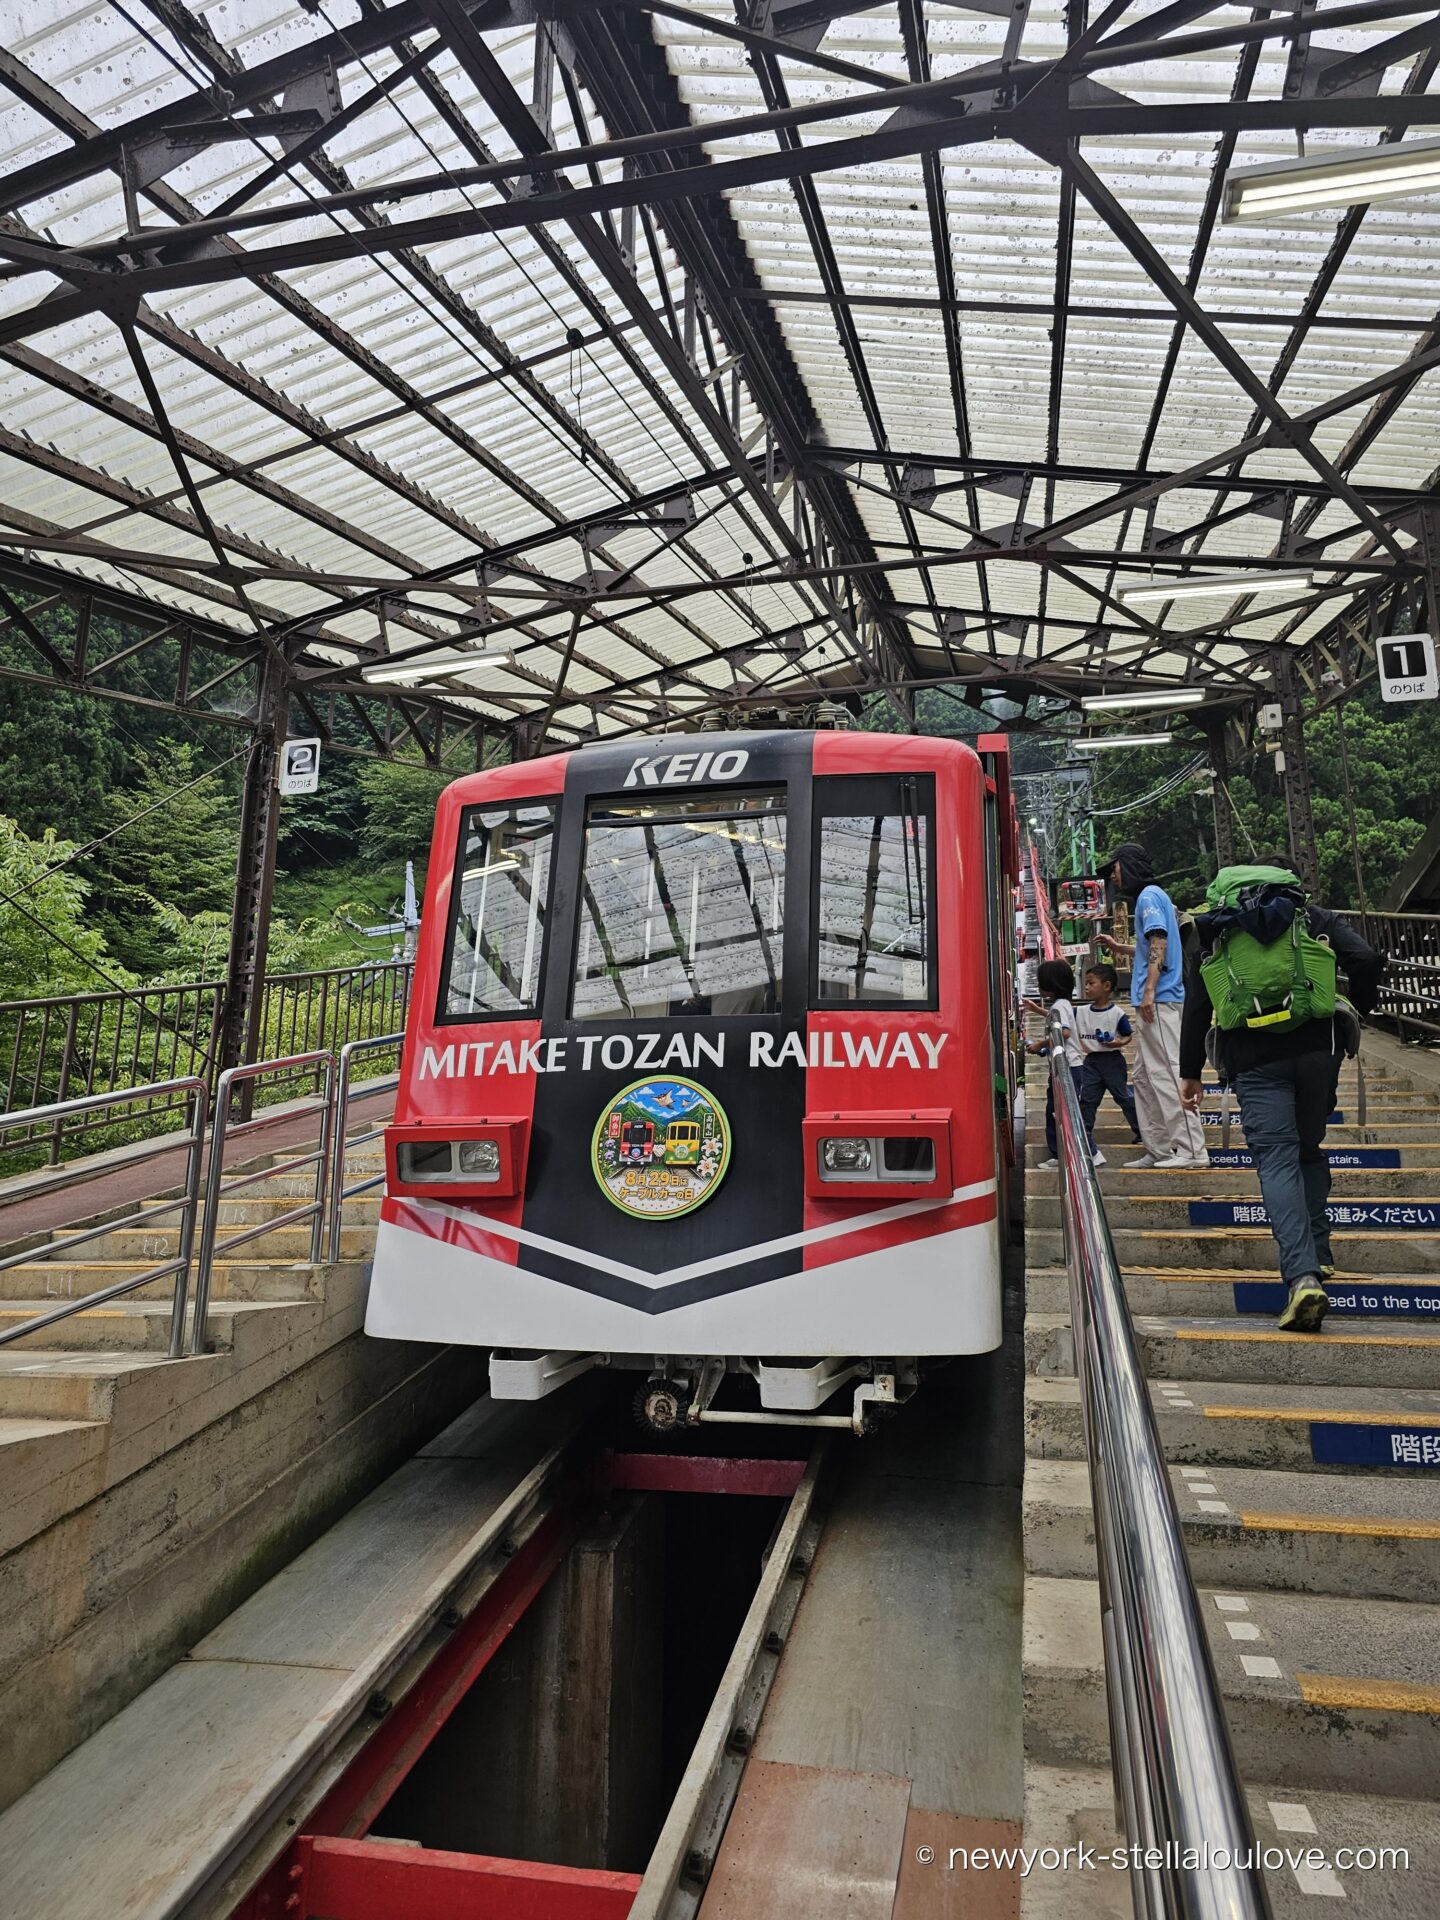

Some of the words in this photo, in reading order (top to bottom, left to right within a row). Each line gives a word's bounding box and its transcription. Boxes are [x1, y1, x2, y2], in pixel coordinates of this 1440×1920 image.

[1392, 645, 1409, 676] 1
[1390, 682, 1425, 695] のりば
[291, 747, 313, 773] 2
[623, 750, 749, 787] KEIO
[288, 778, 312, 789] のりば
[418, 1037, 568, 1080] MITAKE
[576, 1033, 725, 1071] TOZAN
[749, 1031, 949, 1069] RAILWAY
[1208, 1155, 1238, 1164] oceed
[1241, 1155, 1252, 1164] to
[1328, 1154, 1362, 1165] stairs.
[619, 1187, 695, 1200] ケーブルカーの日
[1361, 1295, 1378, 1308] to
[1382, 1295, 1409, 1309] the
[1414, 1296, 1440, 1311] top
